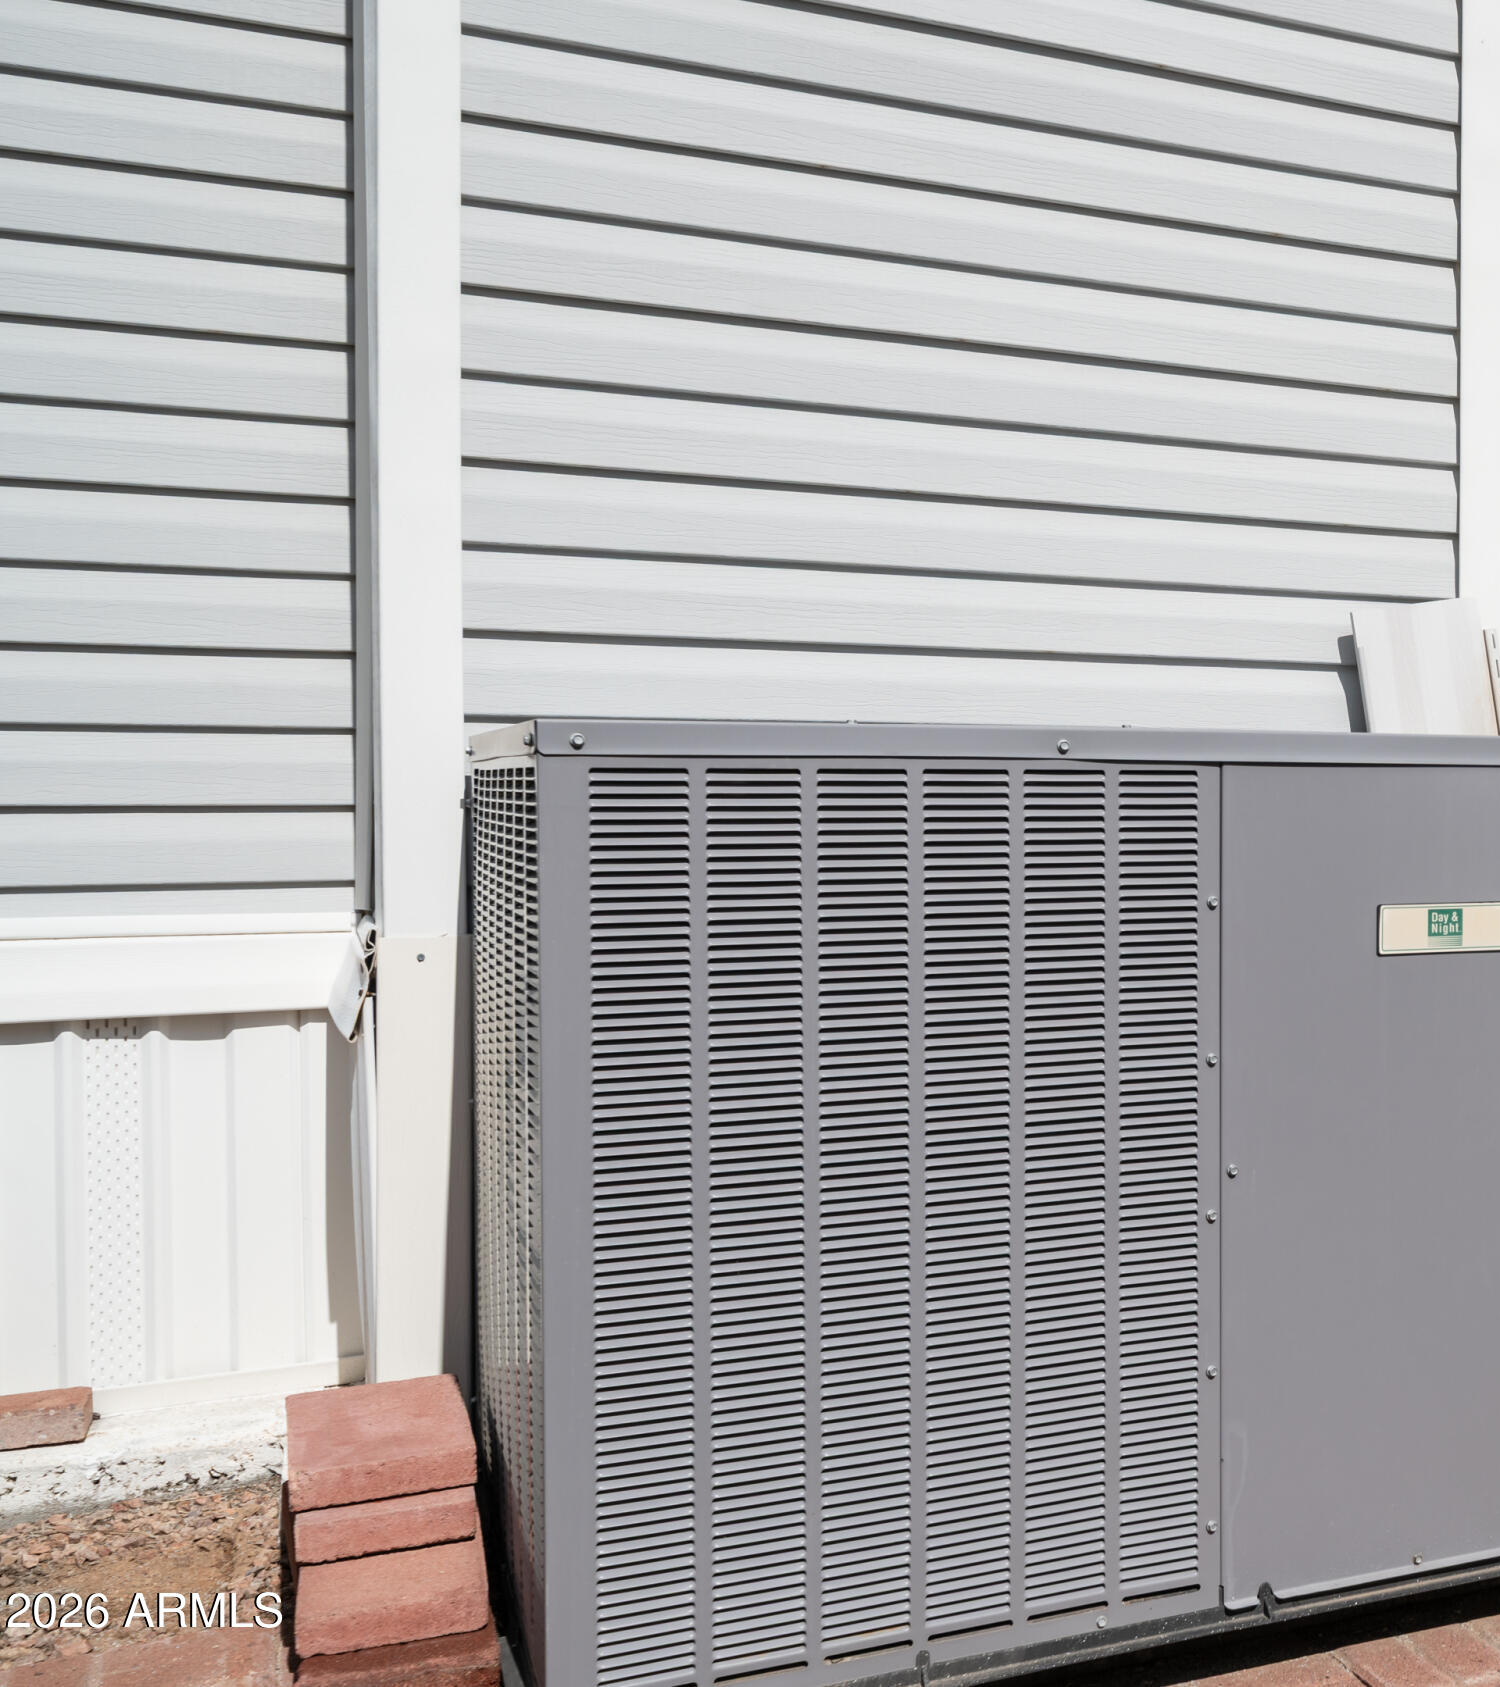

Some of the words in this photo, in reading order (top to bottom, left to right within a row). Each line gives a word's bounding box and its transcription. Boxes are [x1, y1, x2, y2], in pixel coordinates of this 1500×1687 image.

[1431, 912, 1449, 924] Day
[1451, 911, 1458, 922] &
[1431, 922, 1459, 935] Night
